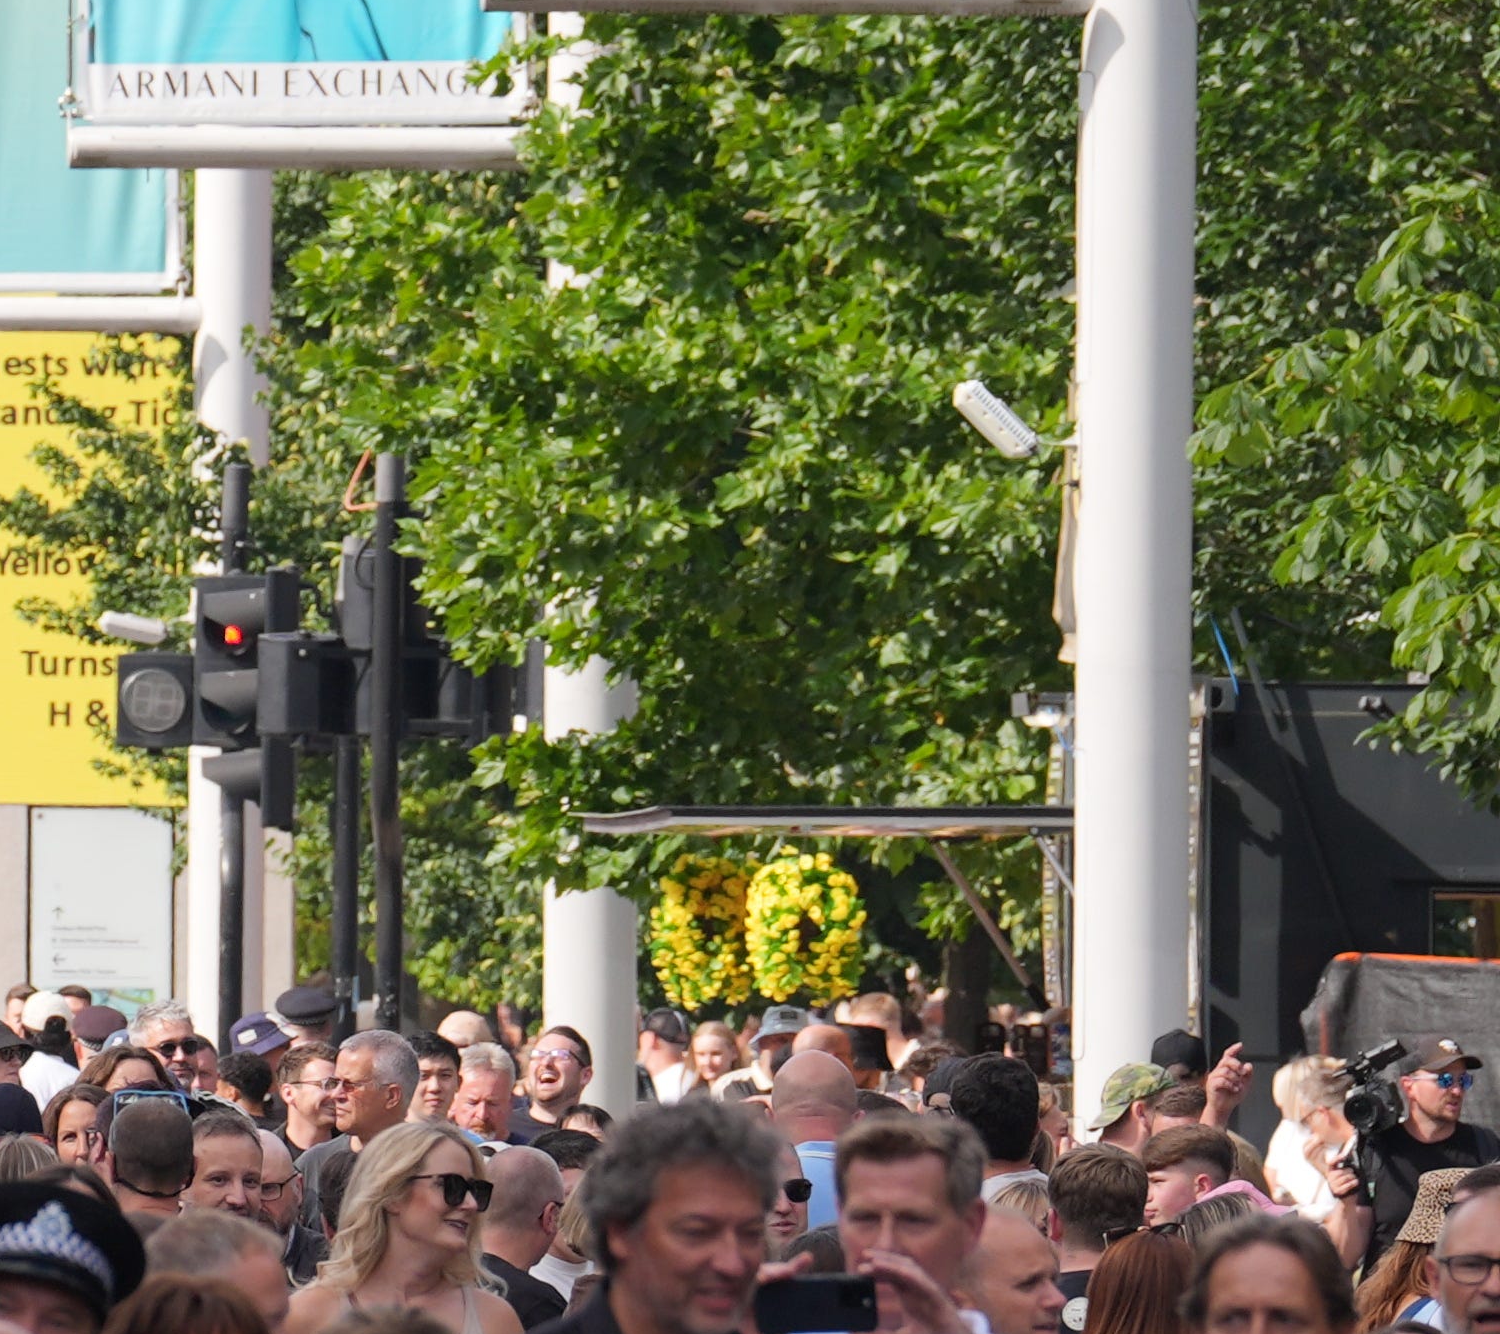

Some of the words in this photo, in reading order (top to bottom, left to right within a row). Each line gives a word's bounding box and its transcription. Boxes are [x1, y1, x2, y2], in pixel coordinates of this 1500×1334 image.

[107, 69, 259, 99] ARMANI
[283, 68, 492, 98] EXCHANG
[21, 650, 116, 677] Turns
[49, 701, 71, 727] H
[85, 700, 109, 727] &
